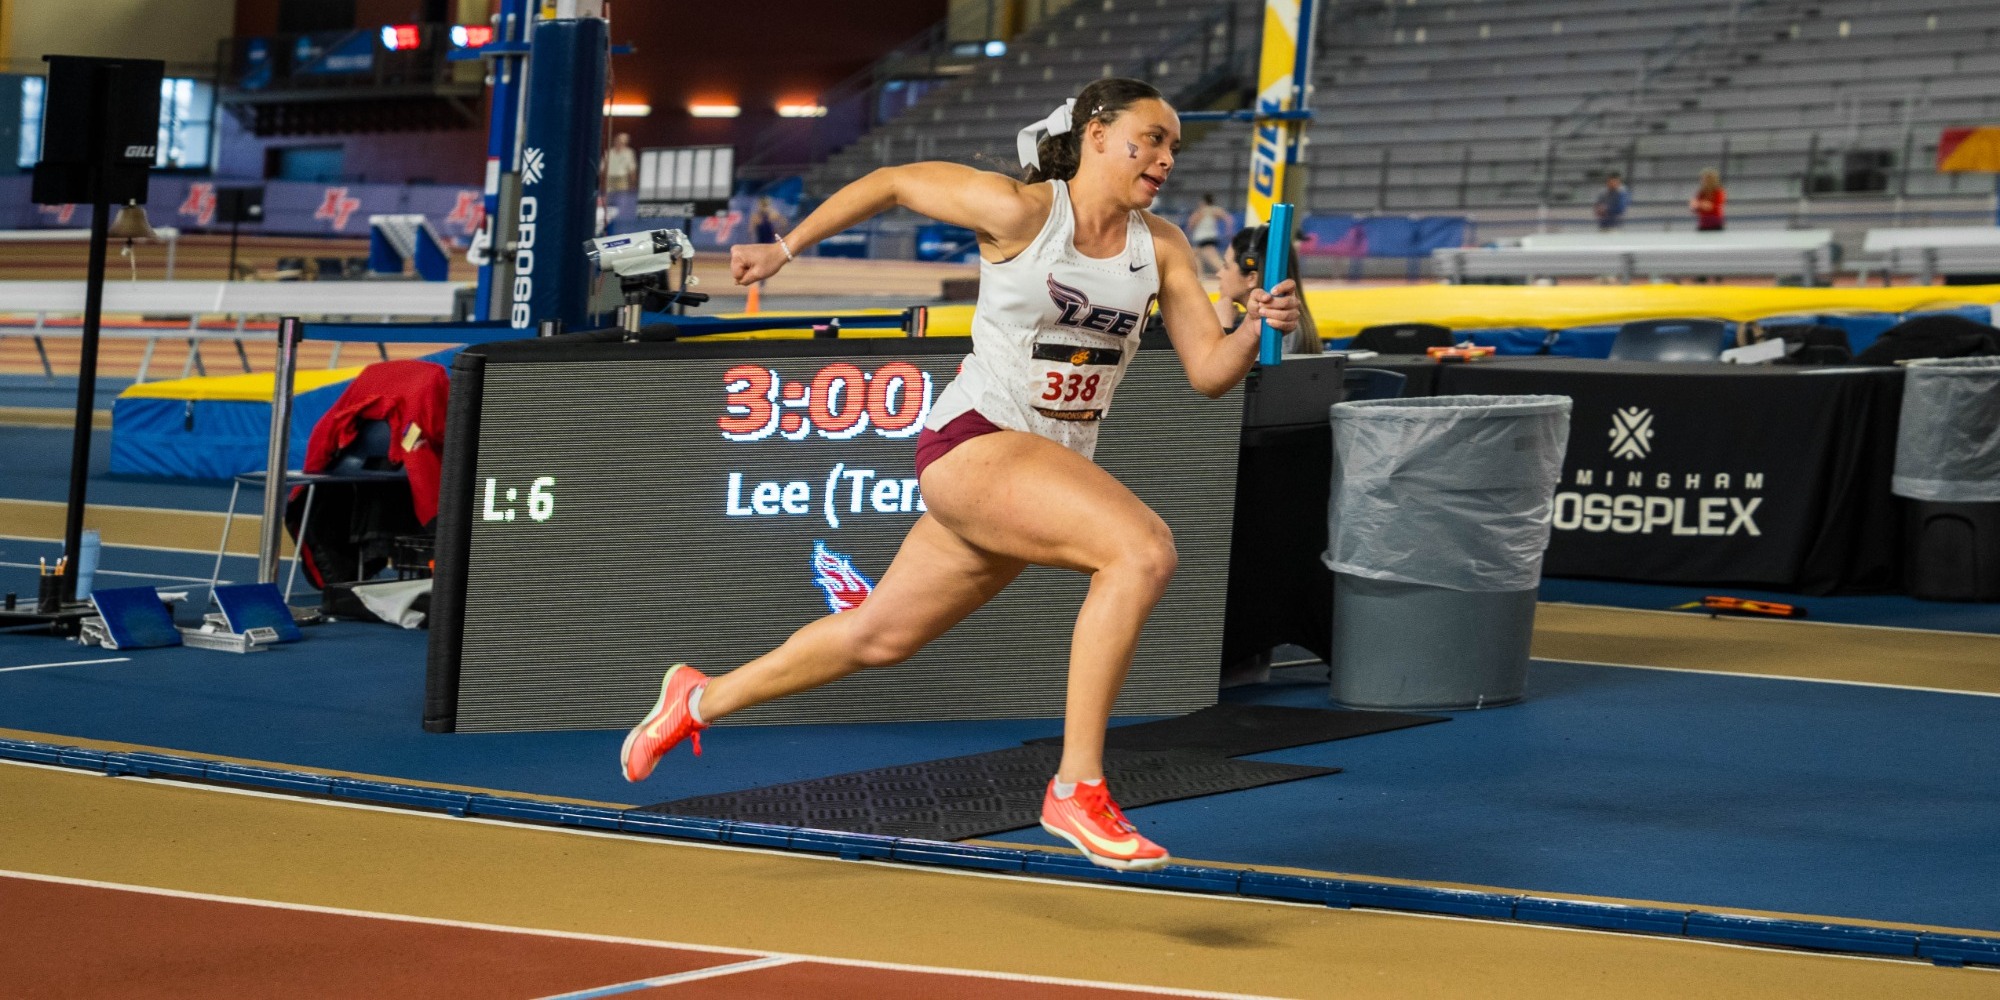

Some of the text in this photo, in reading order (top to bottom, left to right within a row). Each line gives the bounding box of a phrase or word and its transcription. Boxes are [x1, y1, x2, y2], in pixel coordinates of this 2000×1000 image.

[124, 145, 156, 158] GILL
[511, 196, 539, 330] CROSS
[1054, 301, 1140, 338] LEE
[1041, 372, 1100, 402] 338
[482, 476, 555, 523] L: 6
[726, 472, 810, 515] Lee
[1557, 470, 1764, 490] MINGHAM
[1552, 491, 1763, 536] OSSPLEX
